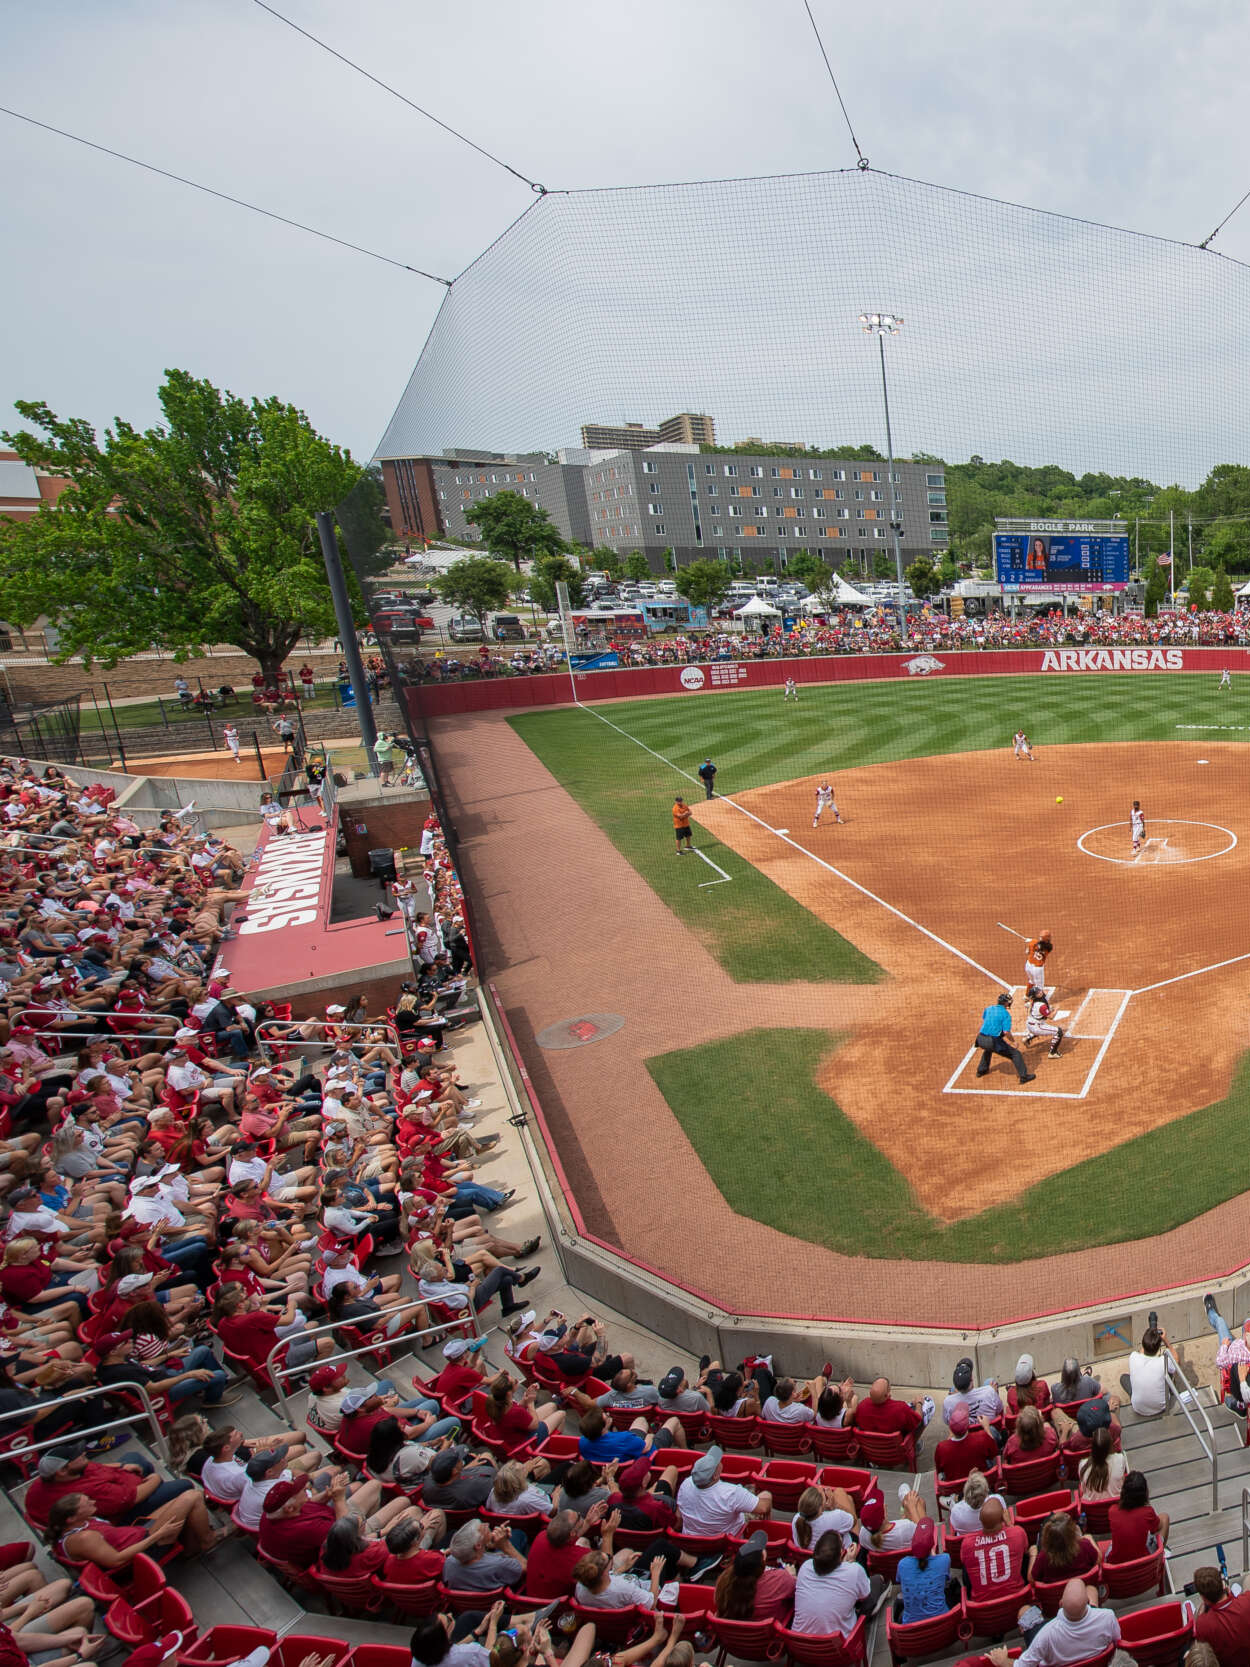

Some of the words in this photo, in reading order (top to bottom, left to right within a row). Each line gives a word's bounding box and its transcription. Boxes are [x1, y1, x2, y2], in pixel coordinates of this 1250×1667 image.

[1031, 523, 1063, 531] BOGLE
[1069, 523, 1095, 532] PARK
[1041, 649, 1183, 671] ARKANSAS
[684, 677, 703, 685] NCAA
[975, 1544, 1011, 1585] 10
